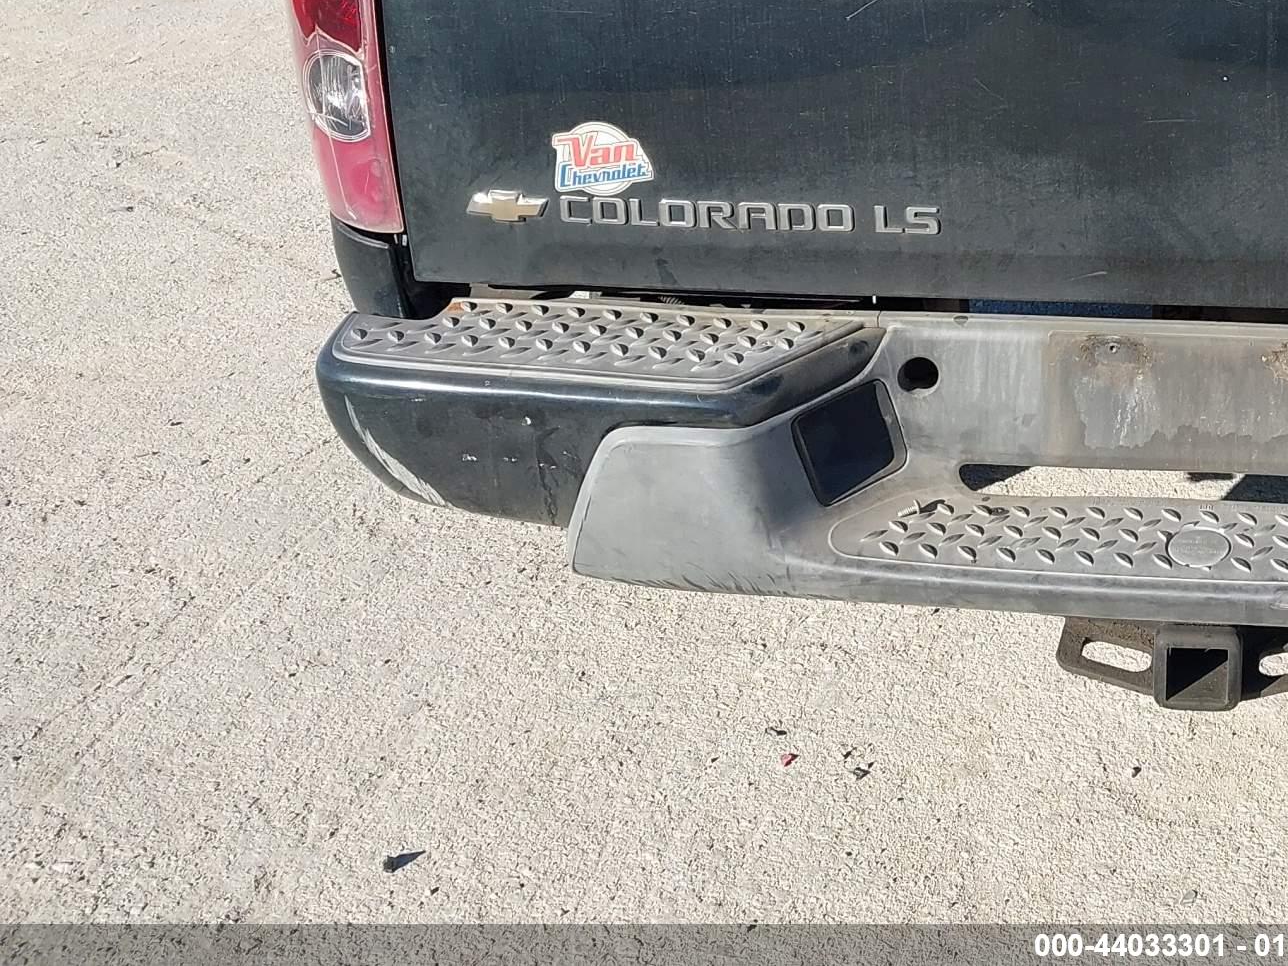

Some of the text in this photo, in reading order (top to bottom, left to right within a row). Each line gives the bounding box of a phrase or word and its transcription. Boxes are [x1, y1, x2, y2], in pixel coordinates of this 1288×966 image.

[556, 133, 636, 168] Van
[560, 161, 647, 188] Chevrolet
[559, 195, 942, 235] COLORADO LS
